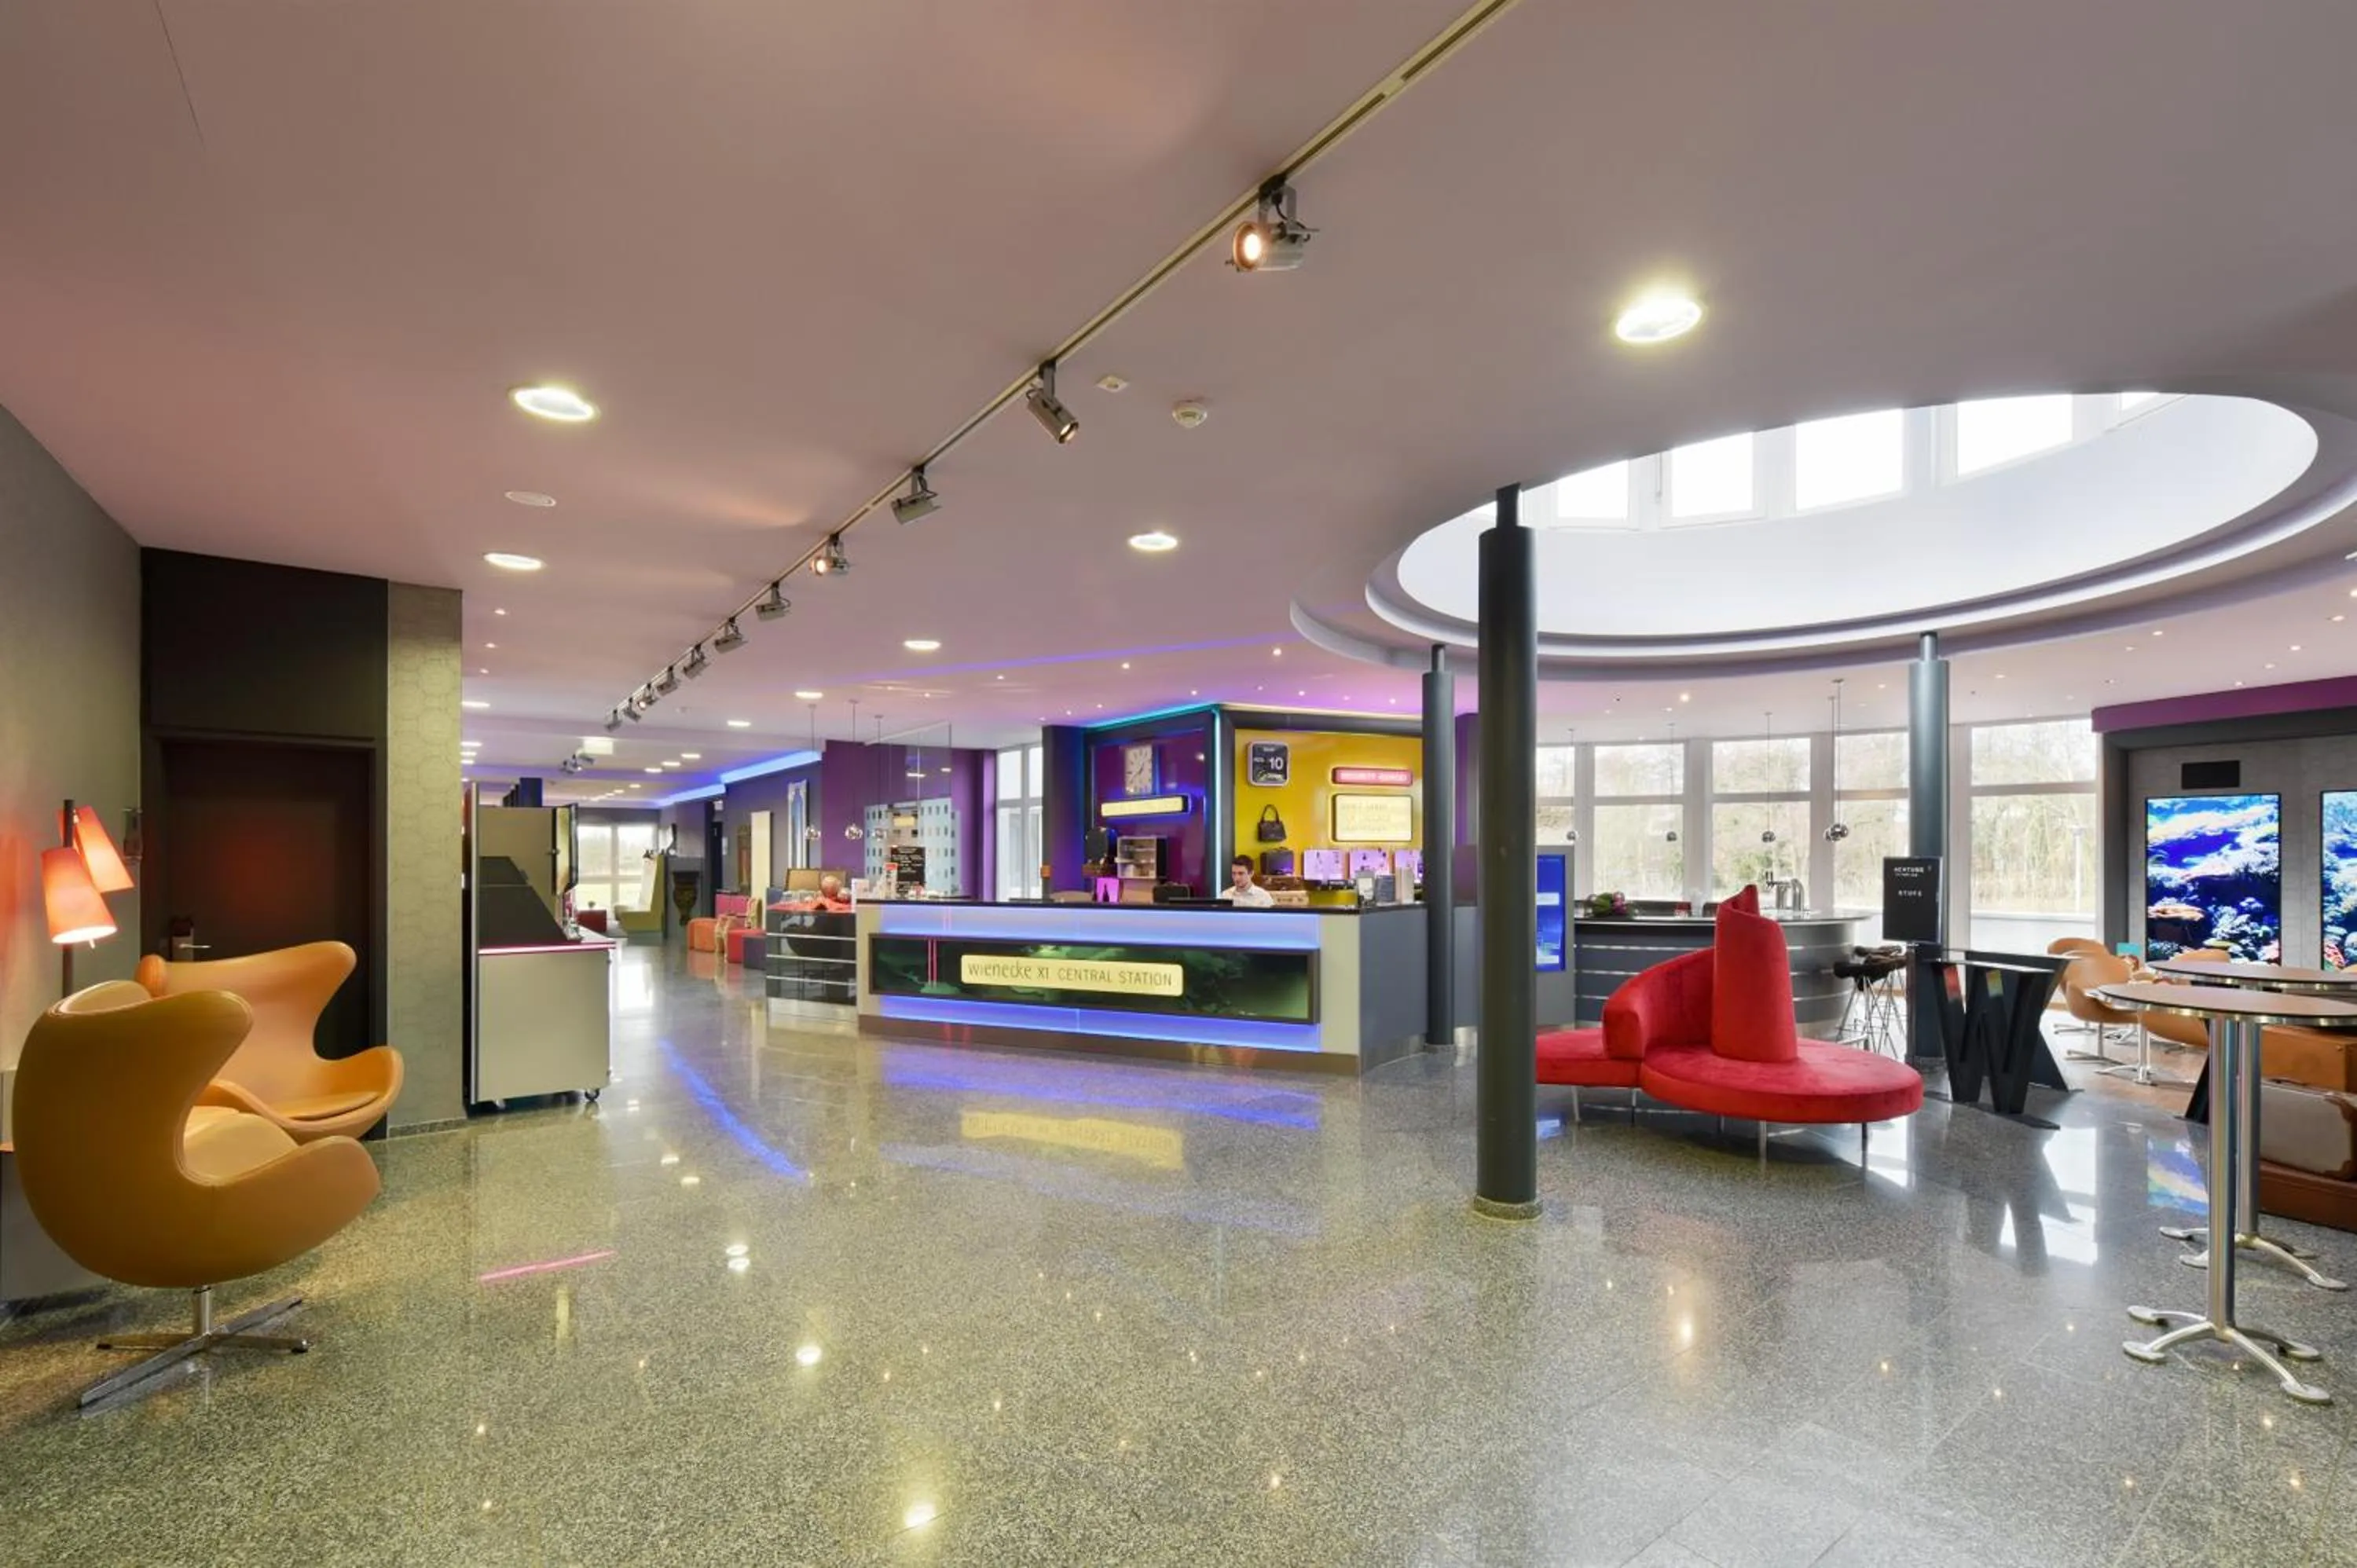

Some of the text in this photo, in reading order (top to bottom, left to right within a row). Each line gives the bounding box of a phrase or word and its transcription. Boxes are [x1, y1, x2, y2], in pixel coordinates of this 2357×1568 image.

[1269, 757, 1284, 771] 10
[968, 960, 1032, 980] wienecke
[1058, 968, 1113, 983] CENTRAL
[1119, 972, 1172, 987] STATION
